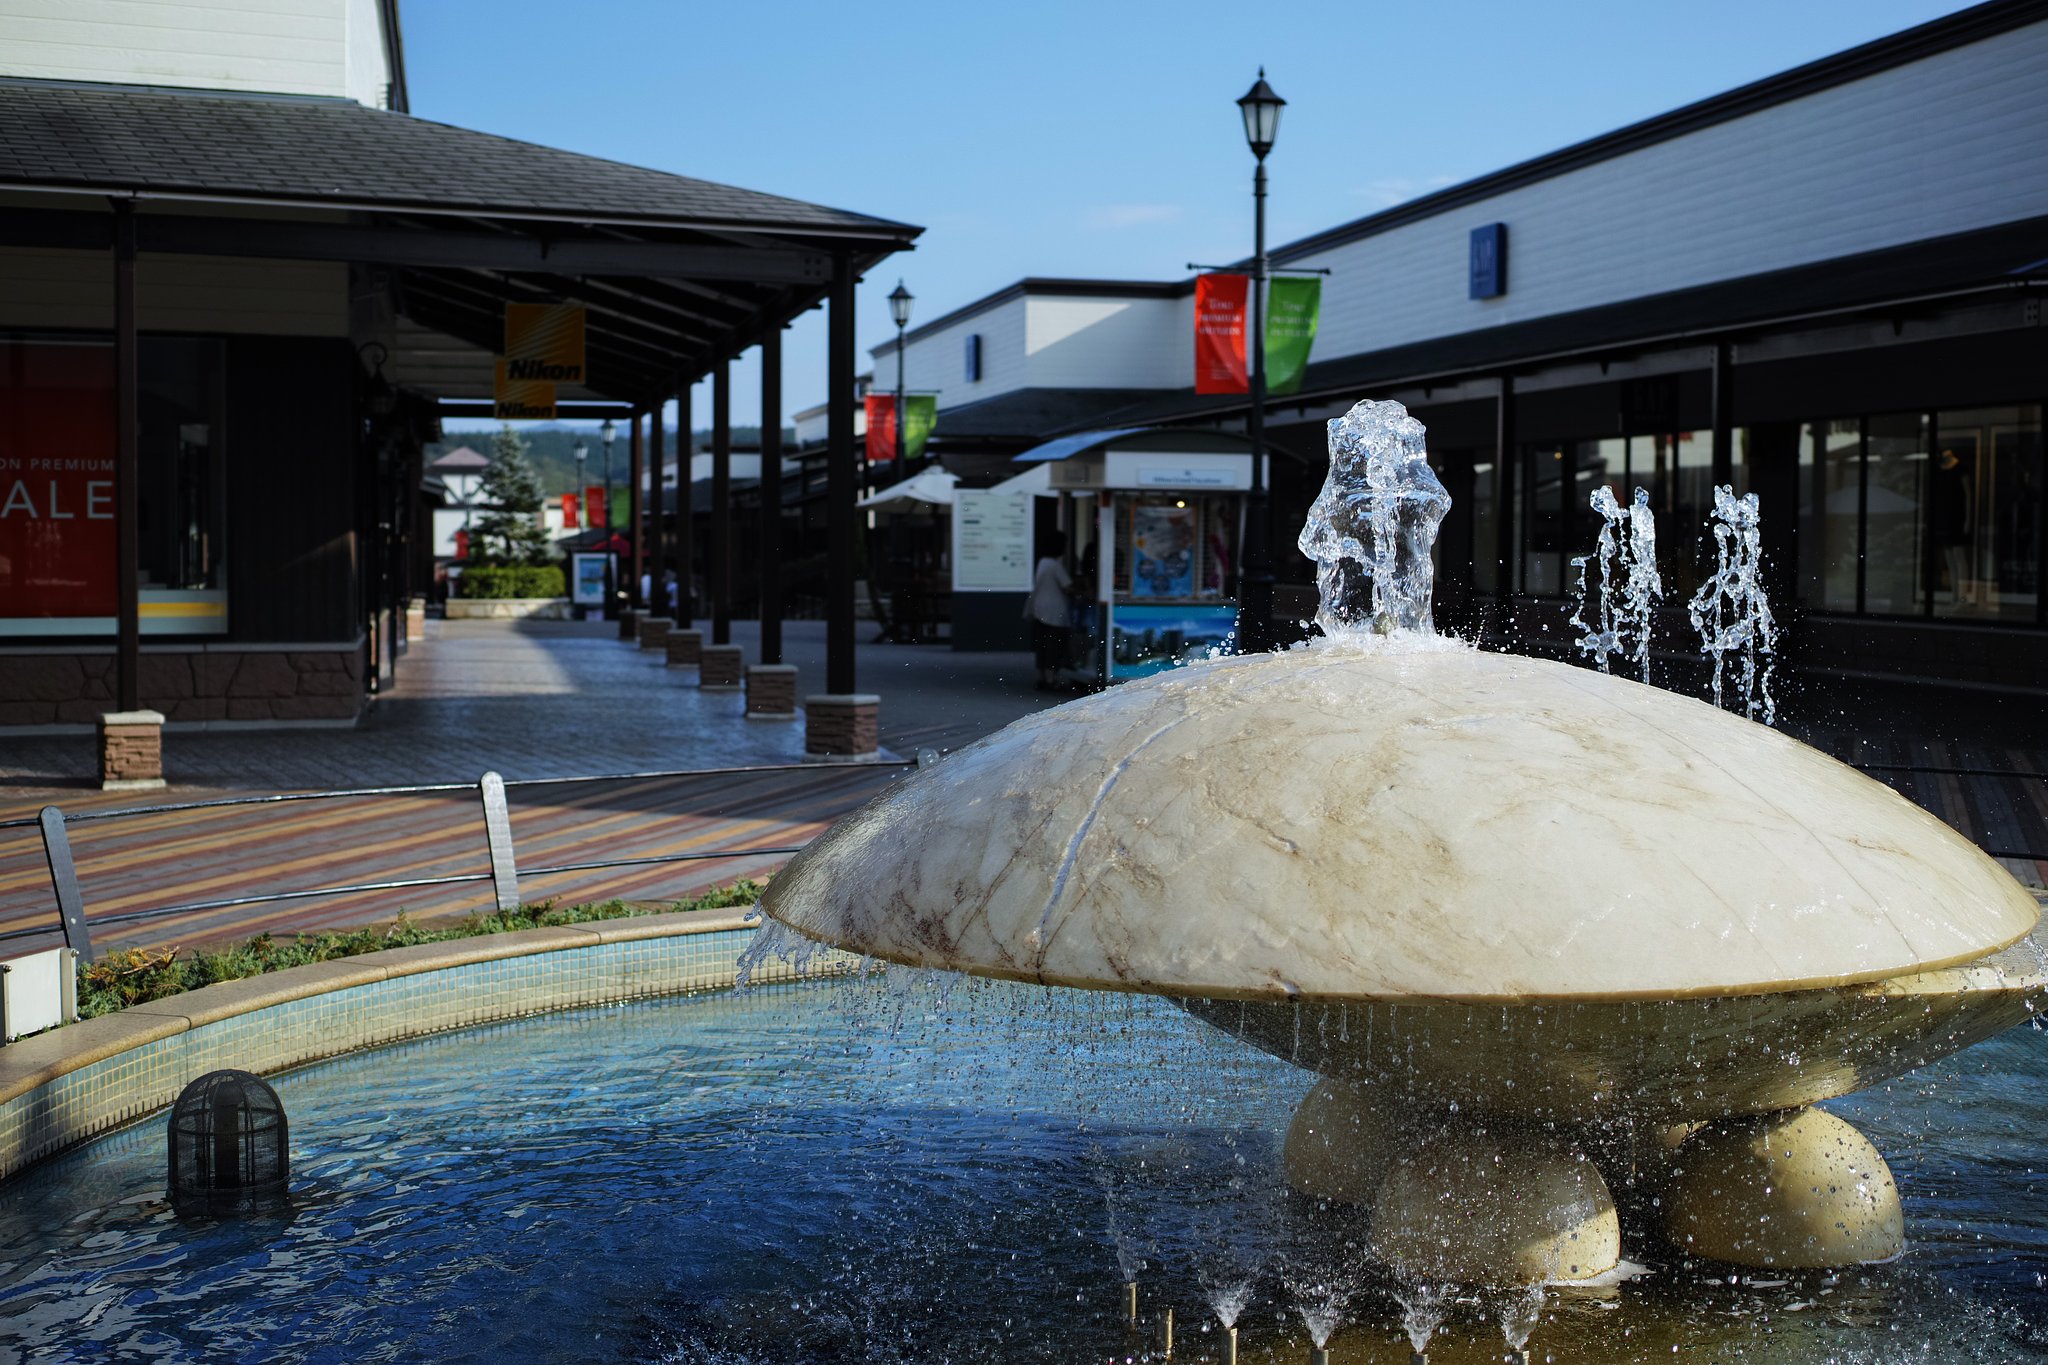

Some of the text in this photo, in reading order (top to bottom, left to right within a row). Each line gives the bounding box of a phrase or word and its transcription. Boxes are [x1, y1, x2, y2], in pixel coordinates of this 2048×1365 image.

[509, 359, 581, 380] Nikon
[498, 403, 553, 417] Nikon
[30, 458, 114, 471] PREMIUM
